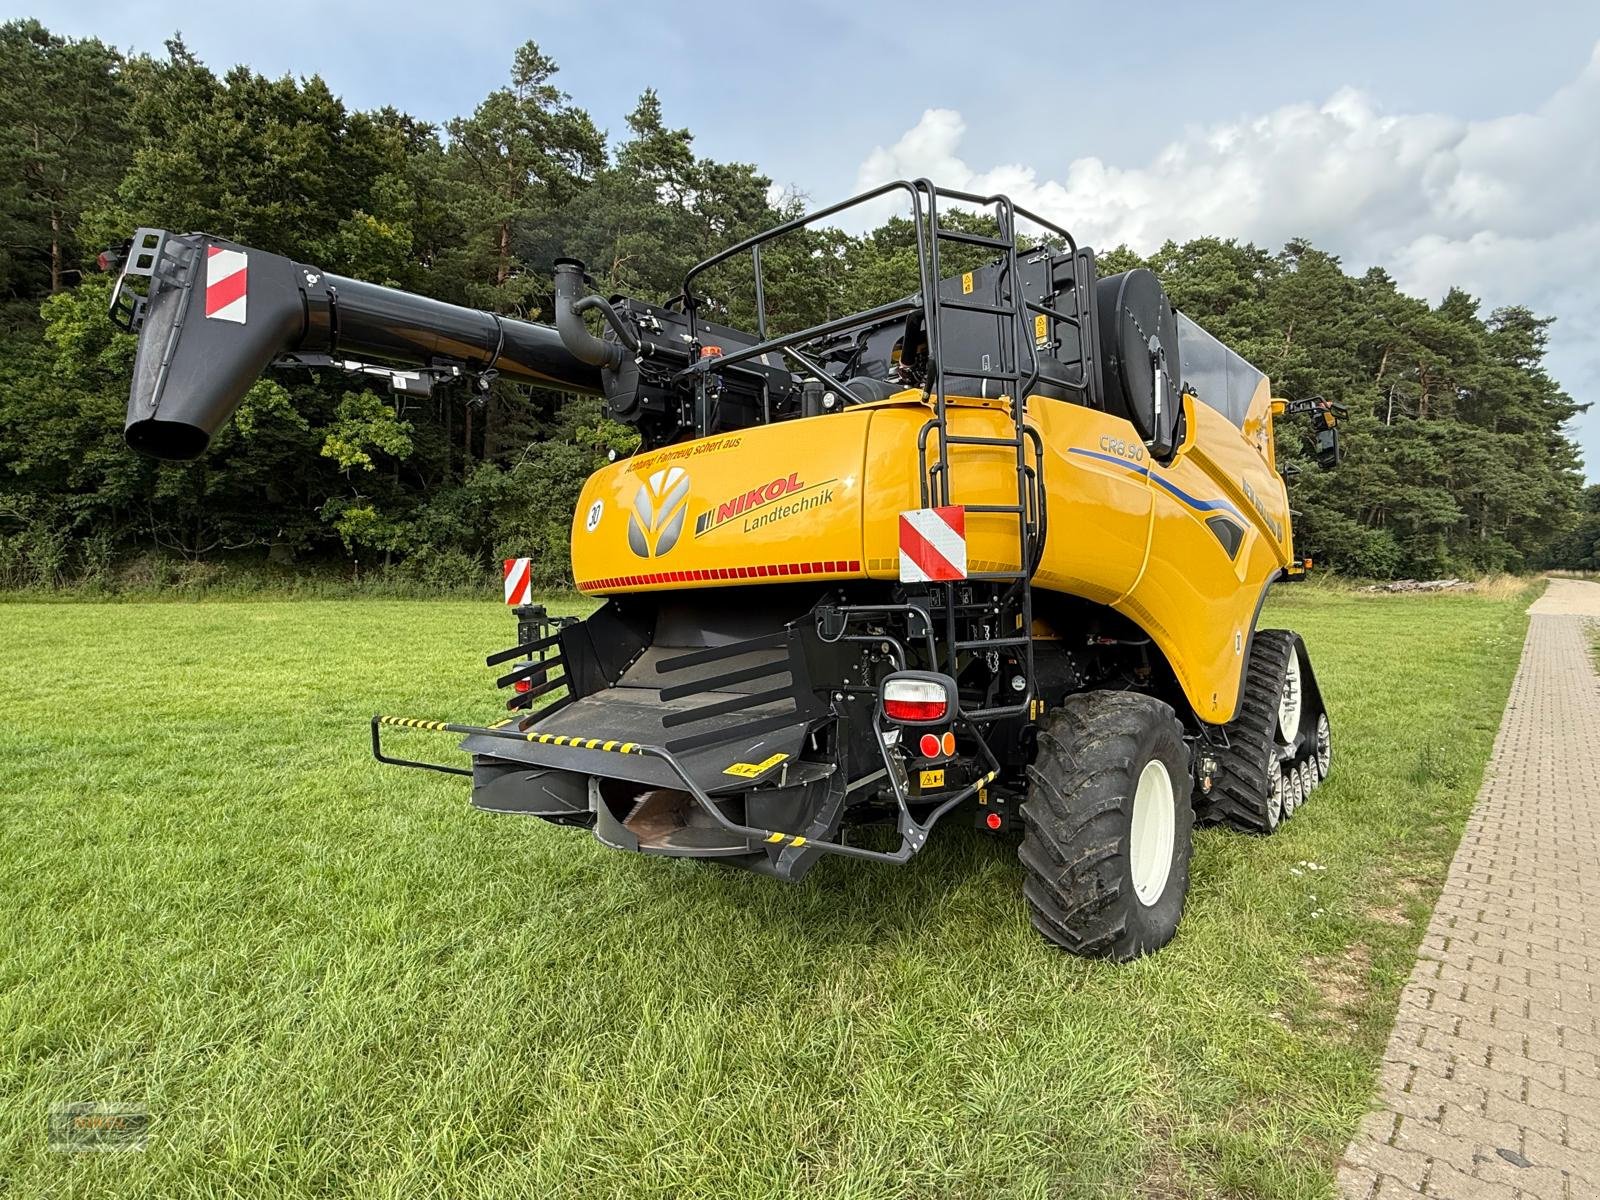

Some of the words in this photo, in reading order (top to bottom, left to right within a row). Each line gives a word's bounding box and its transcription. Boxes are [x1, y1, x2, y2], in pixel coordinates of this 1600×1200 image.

[656, 447, 693, 463] Fahrzeug
[694, 439, 723, 455] schert
[723, 438, 742, 449] aus
[1100, 434, 1143, 461] CR8.90
[716, 472, 804, 524] NIKOL
[743, 489, 833, 533] Landtechnik
[589, 504, 601, 527] 30
